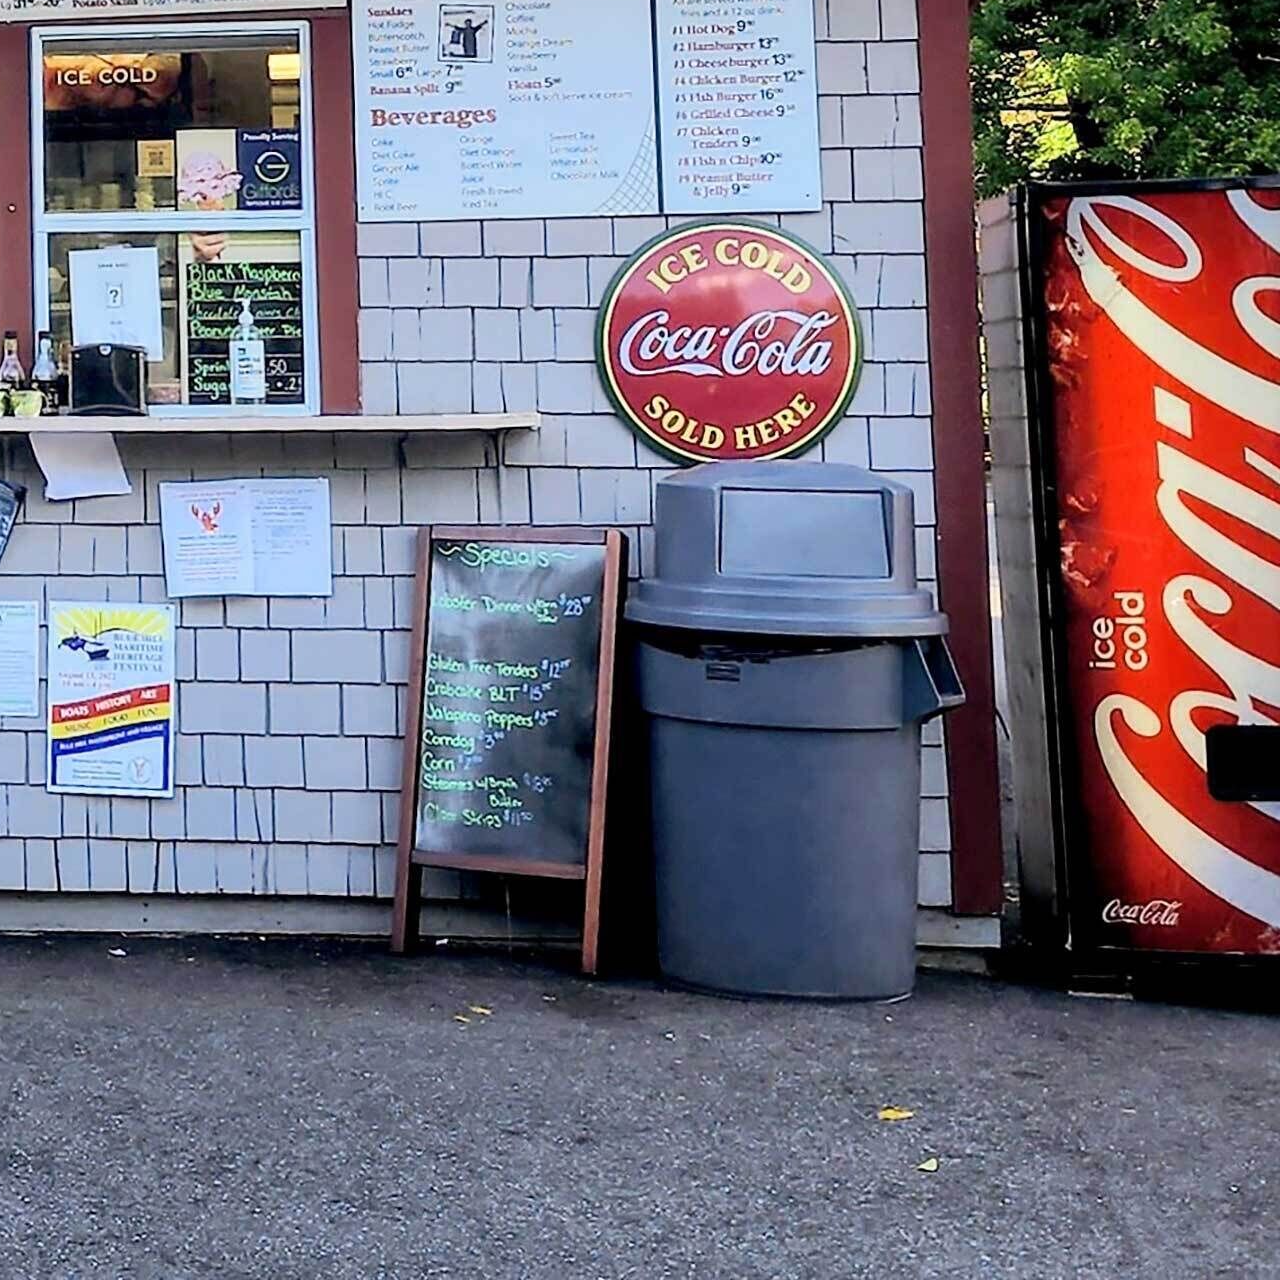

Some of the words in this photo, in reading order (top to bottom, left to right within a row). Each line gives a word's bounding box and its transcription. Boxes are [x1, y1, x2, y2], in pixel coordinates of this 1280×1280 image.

[56, 68, 93, 86] ICE
[98, 66, 158, 86] COLD
[369, 106, 498, 129] Beverages
[645, 242, 710, 295] ICE
[713, 237, 814, 296] COLD
[643, 394, 727, 451] SOLD
[733, 392, 818, 451] HERE
[461, 542, 550, 573] Specials
[1089, 615, 1117, 670] ice
[1113, 590, 1149, 672] cold
